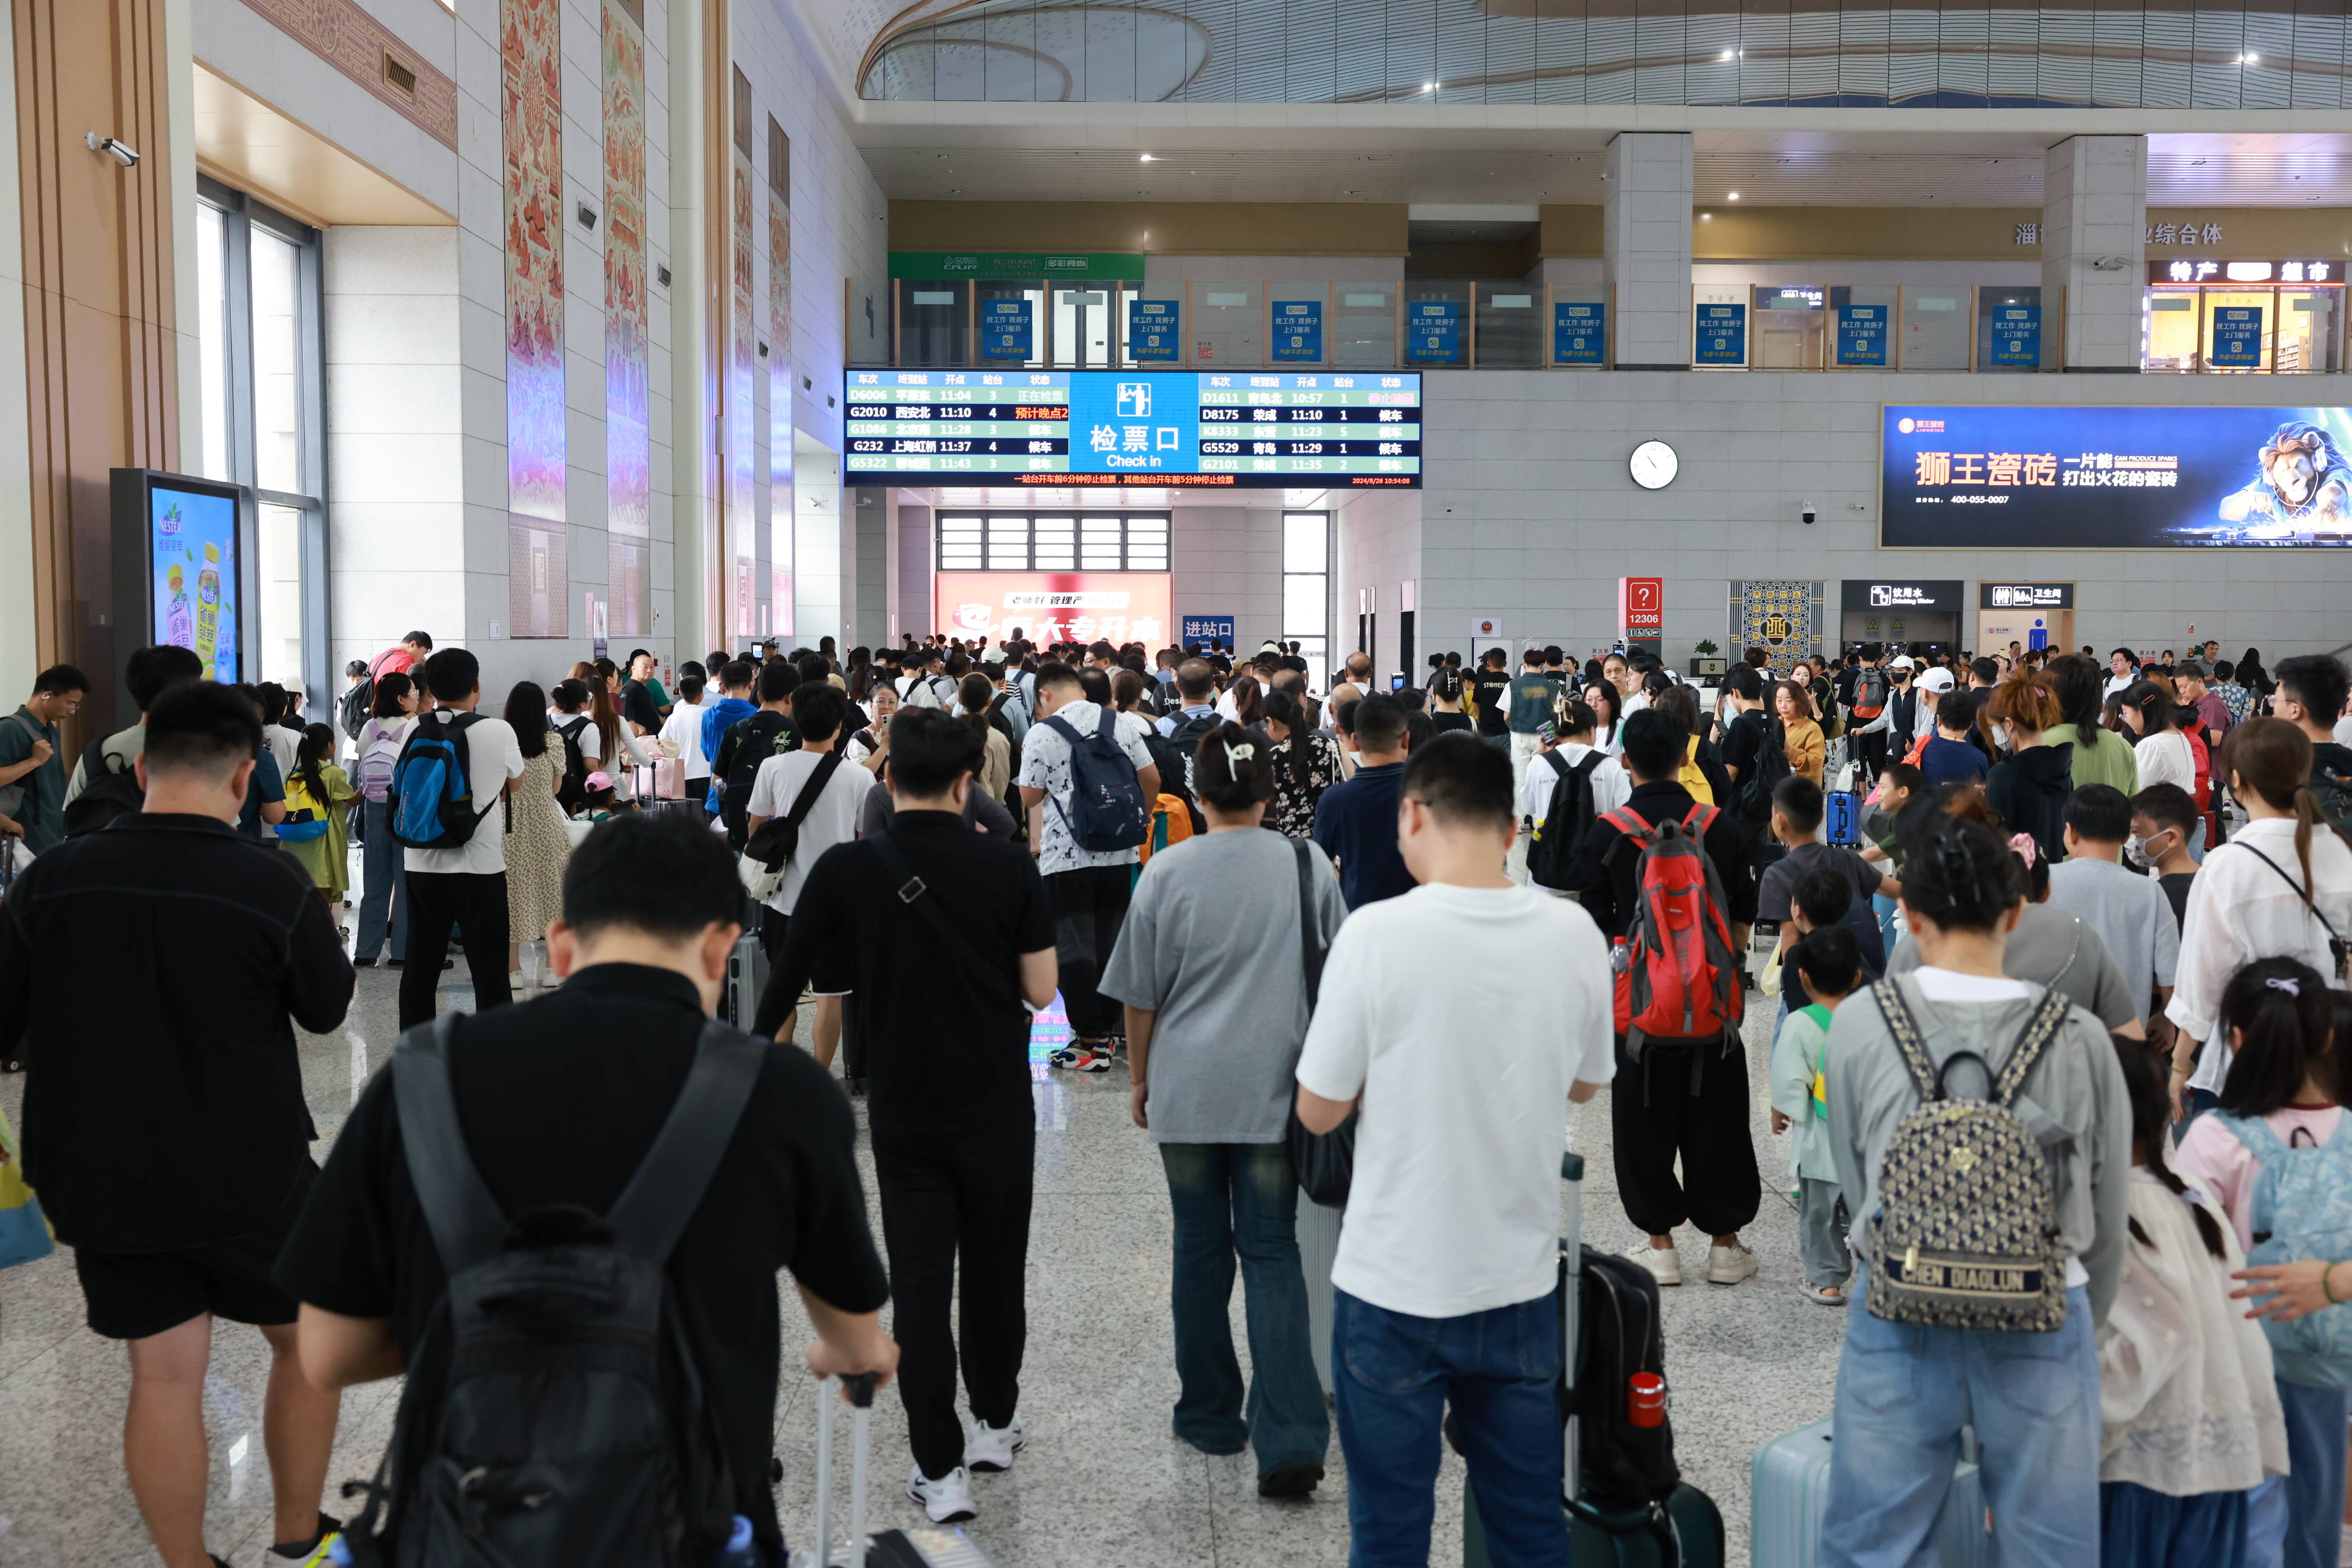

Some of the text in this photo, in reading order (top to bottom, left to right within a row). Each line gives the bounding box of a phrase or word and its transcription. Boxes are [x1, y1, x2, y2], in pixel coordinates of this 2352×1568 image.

[2016, 223, 2042, 244] 淄
[2170, 261, 2329, 282] 特产 超市
[858, 373, 1050, 385] 车次 终到站 开点 站台 状态
[1210, 376, 1401, 388] 车次 终到站 开点 站台 状态
[850, 389, 1064, 403] D6006 平原东 11:04 3 正在检票
[1202, 392, 1415, 405] D1611 青岛北 10:57 1 停止检票
[850, 406, 1068, 419] G2010 西安北 11:10 4 预计晚点2
[1202, 409, 1402, 422] D8175 荣成 11:10 1 候车
[850, 423, 1053, 436] G1086 北京南 11:28 3 候车
[1202, 425, 1403, 439] K8333 东营 11:23 5 候车
[1090, 425, 1179, 452] 检票口
[854, 440, 1052, 453] G232 上海虹桥 11:37 4 候车
[1202, 442, 1402, 455] G5529 青岛 11:29 1 候车
[850, 457, 888, 469] G5322
[940, 458, 972, 469] 11:43
[989, 458, 997, 469] 3
[1028, 458, 1053, 470] 候车
[1106, 455, 1161, 467] Check in
[1202, 458, 1403, 471] G2101 荣成 11:35 2 候车
[2064, 453, 2113, 469] 一片能
[1916, 452, 2057, 486] 狮王瓷砖
[2063, 470, 2178, 487] 打出火花的瓷砖
[1950, 495, 2009, 504] 400-055-0007
[159, 518, 181, 533] NESTEA
[201, 591, 217, 604] NESTEA
[1892, 587, 1922, 598] 饮用水
[2034, 589, 2061, 598] 卫生间
[169, 600, 185, 614] NESTE
[1012, 596, 1045, 604] 老师好
[1050, 596, 1084, 605] 管理严
[1629, 614, 1659, 623] 12306
[1186, 621, 1231, 637] 进站口
[1901, 1263, 1943, 1286] CHEN
